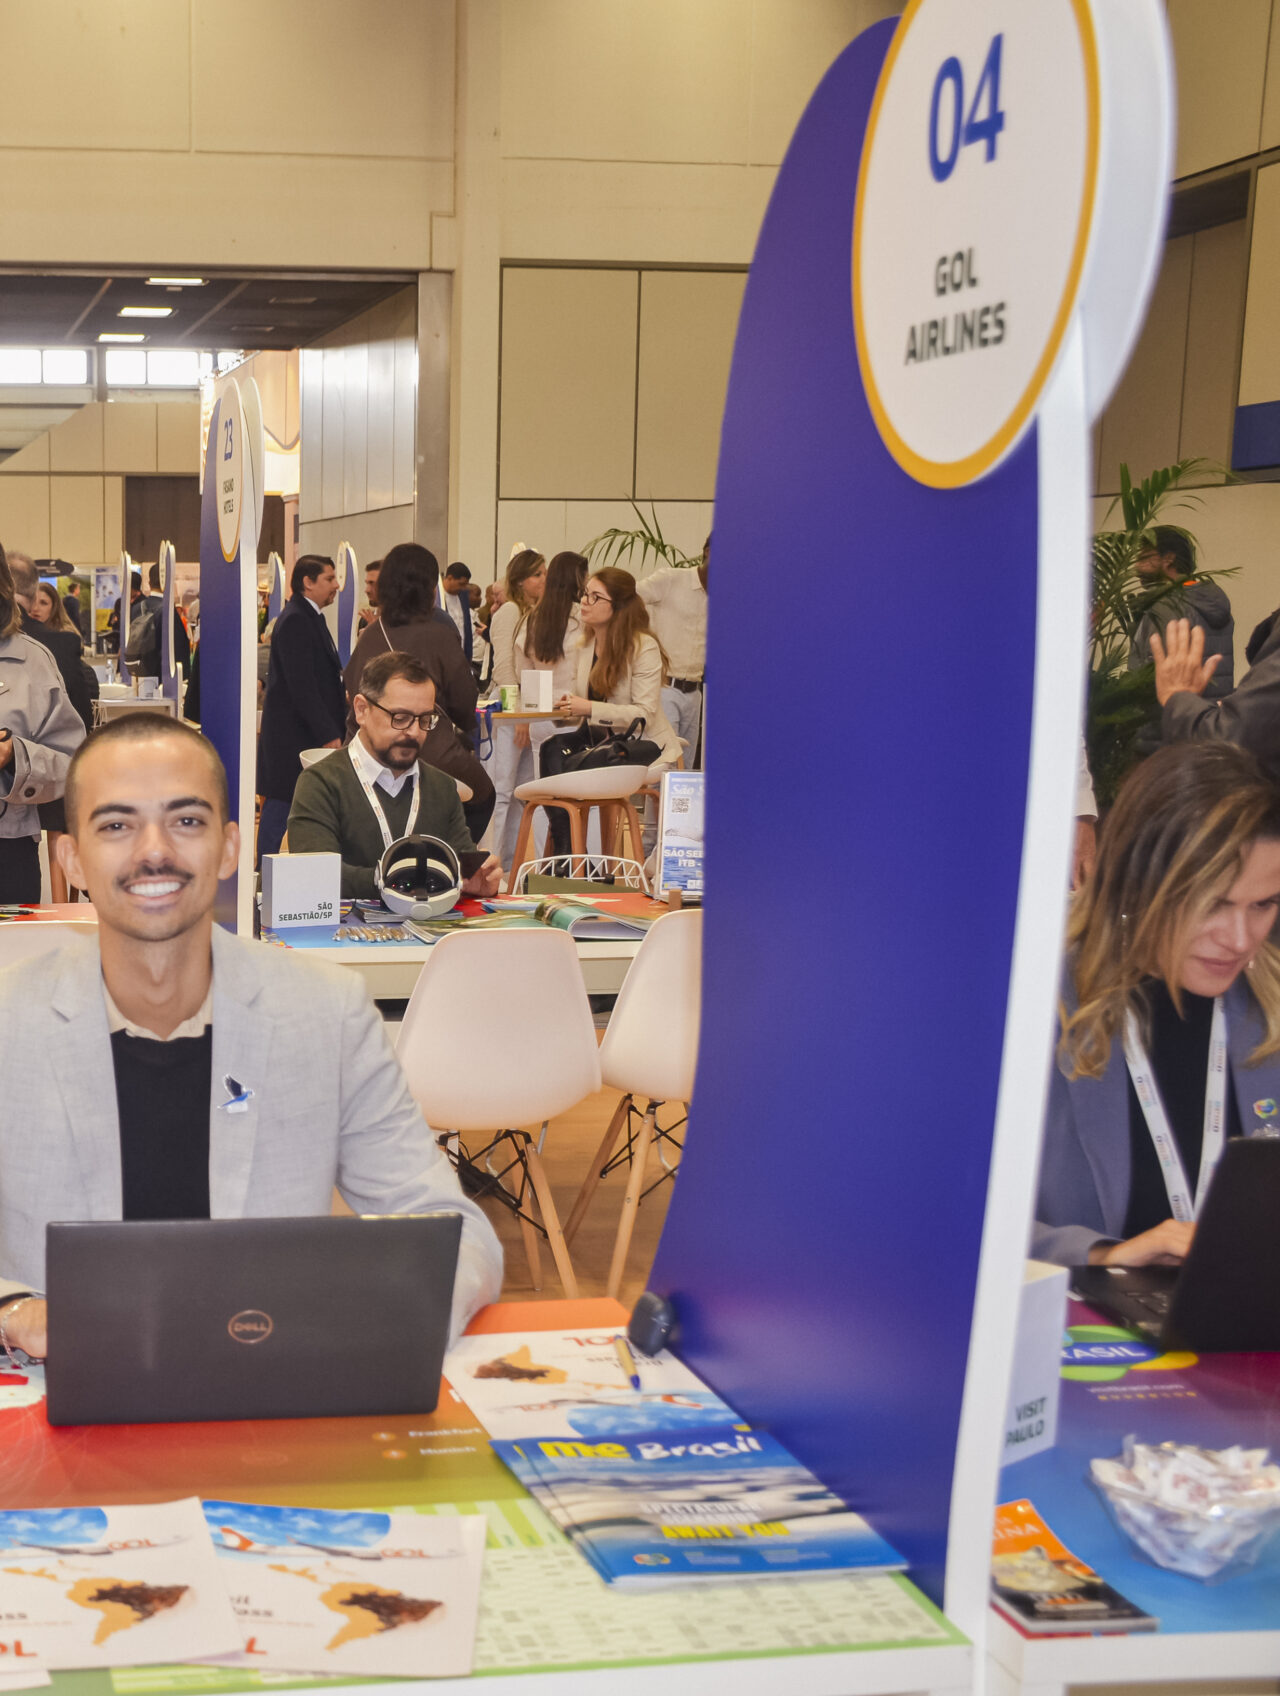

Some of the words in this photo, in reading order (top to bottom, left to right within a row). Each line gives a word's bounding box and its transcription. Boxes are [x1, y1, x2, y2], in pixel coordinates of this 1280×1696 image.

[928, 32, 1005, 183] 04
[934, 247, 980, 297] GOL
[904, 302, 1007, 366] AIRLINES
[223, 418, 234, 461] 23
[278, 911, 333, 922] SEBASTIÃO/SP
[317, 902, 333, 911] SÃO
[1061, 1345, 1148, 1361] ASIL
[1015, 1396, 1047, 1423] VISIT
[636, 1434, 763, 1461] Brasil
